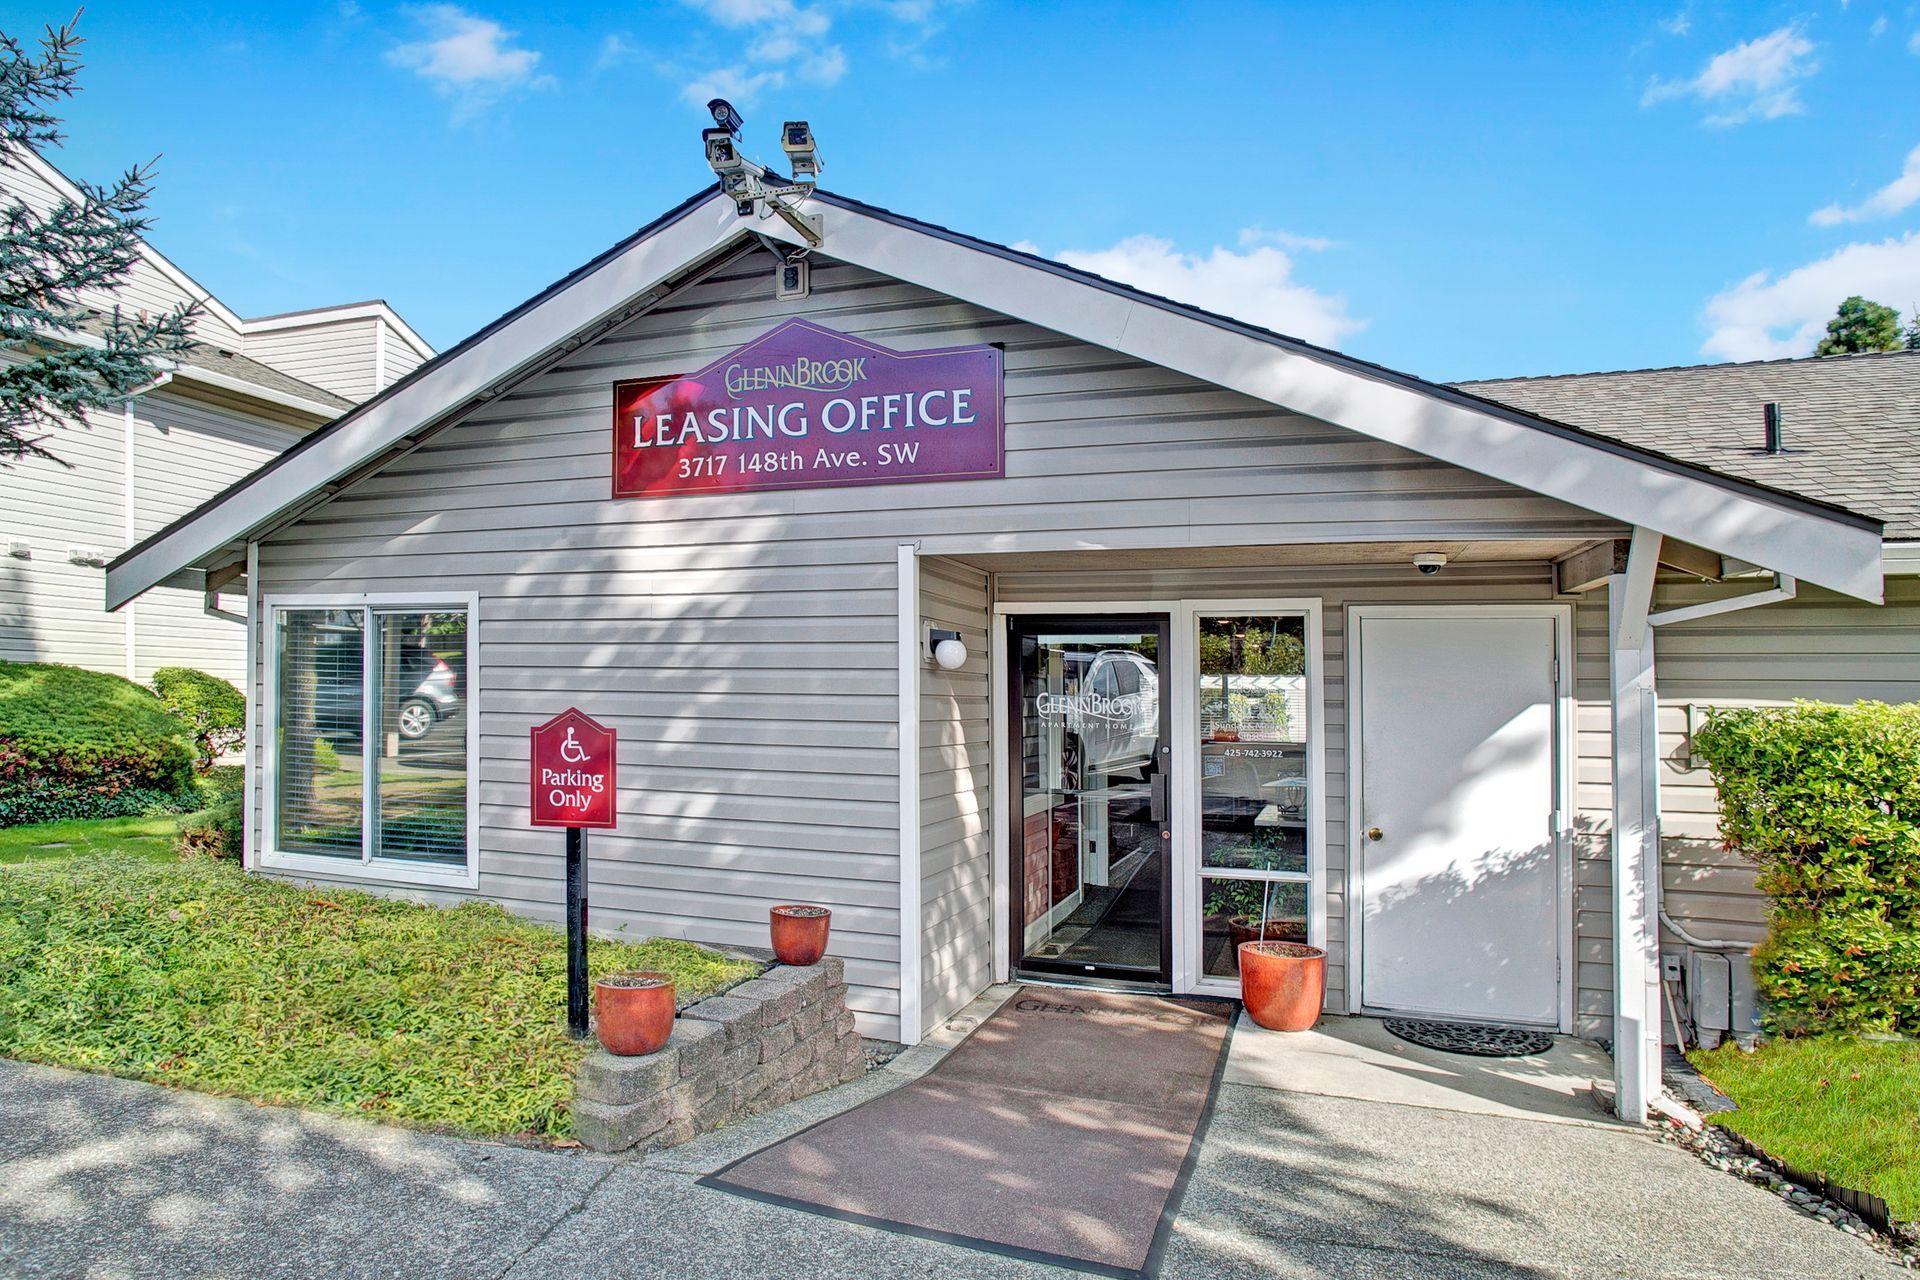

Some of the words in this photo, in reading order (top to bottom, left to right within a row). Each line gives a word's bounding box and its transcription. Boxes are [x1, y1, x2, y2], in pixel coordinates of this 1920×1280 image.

[633, 402, 808, 448] LEASING
[821, 388, 977, 433] OFFICE
[678, 456, 727, 479] 3717
[738, 450, 803, 475] 148th
[812, 447, 868, 469] Ave.
[877, 442, 920, 465] SW
[1224, 749, 1284, 758] 425-742-3922
[542, 768, 604, 792] Parking
[549, 789, 592, 812] Only
